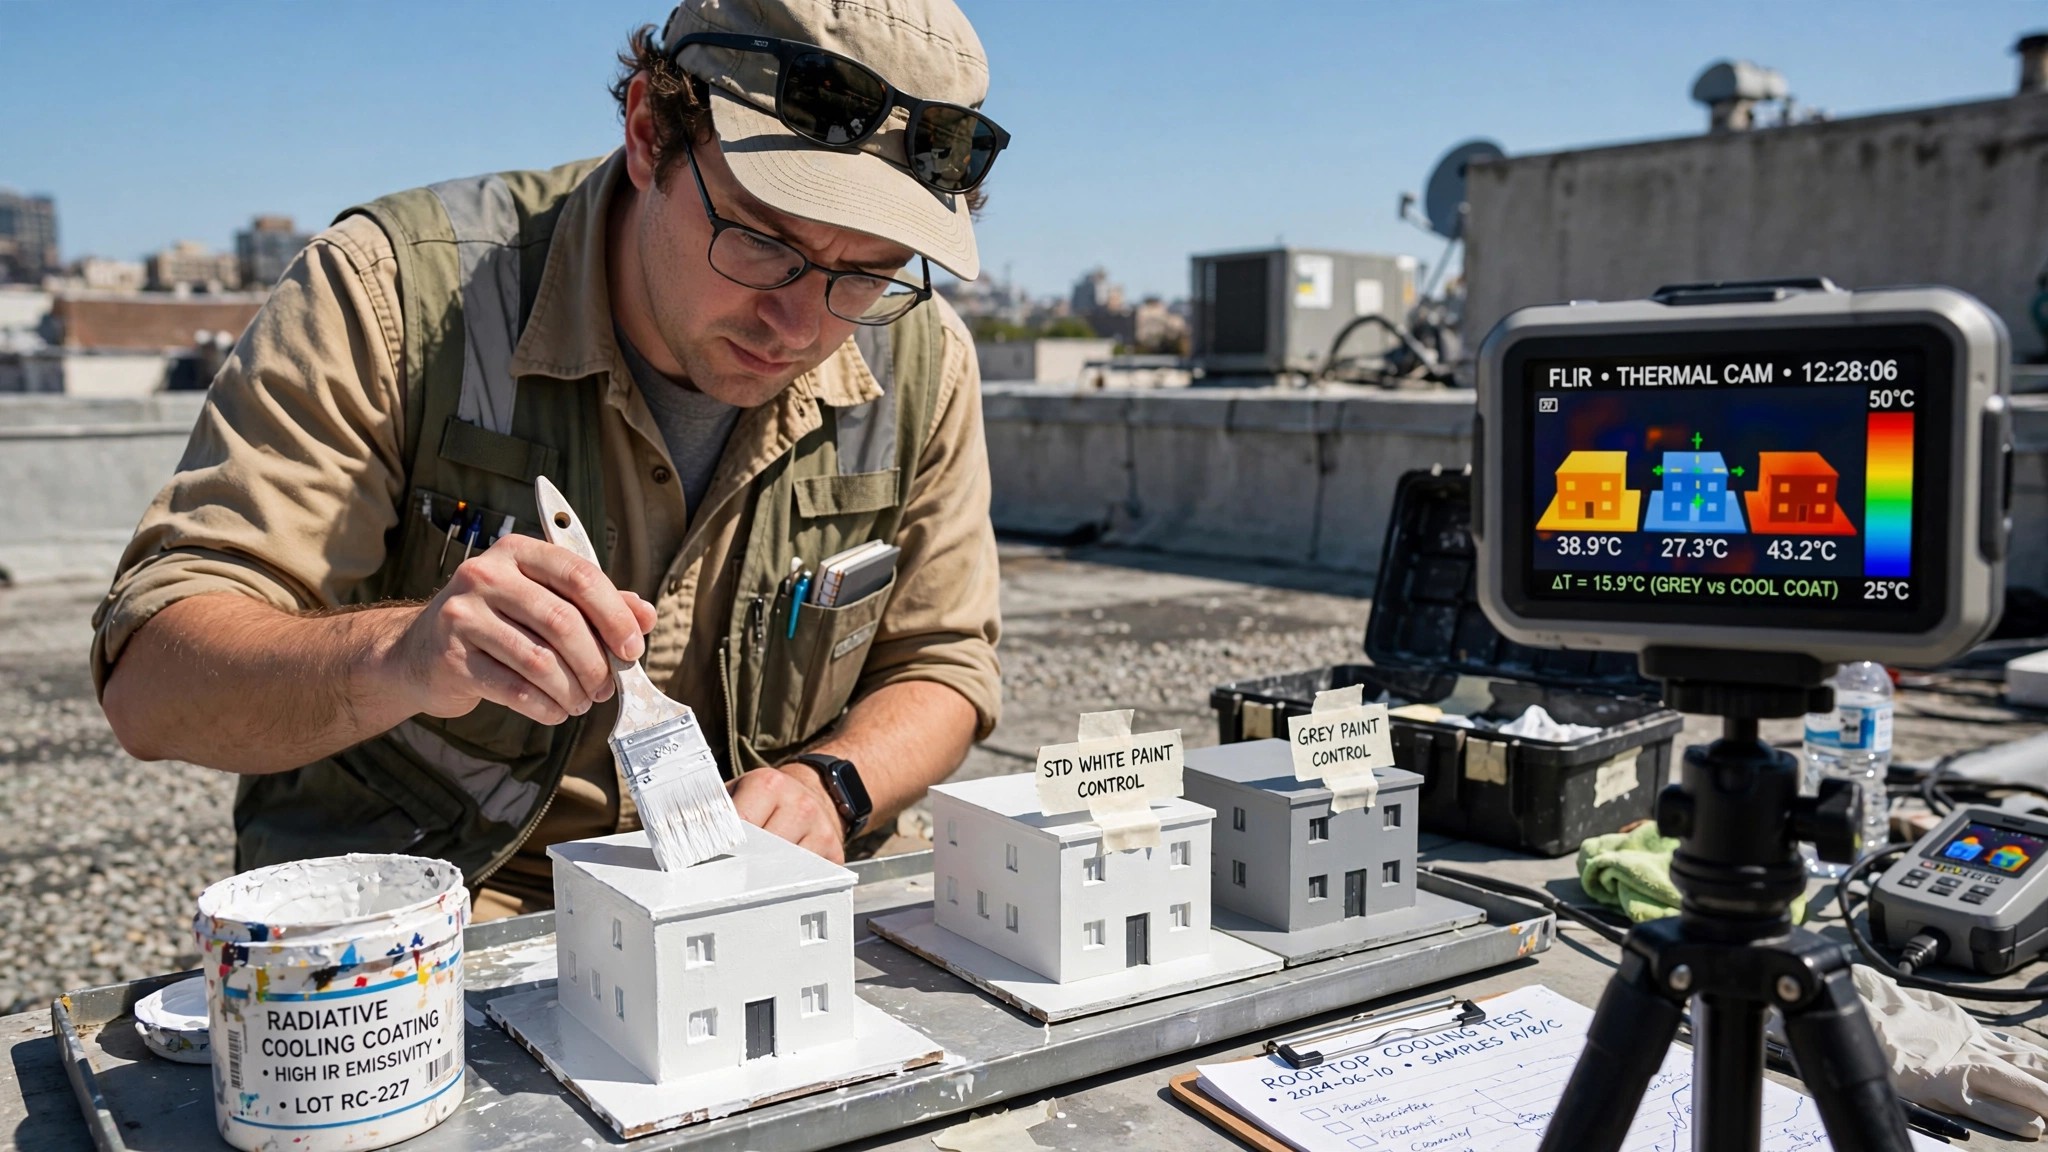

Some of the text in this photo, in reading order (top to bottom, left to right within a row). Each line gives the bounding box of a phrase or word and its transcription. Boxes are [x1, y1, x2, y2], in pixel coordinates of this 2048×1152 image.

[1549, 360, 1898, 388] FLIR THERMAL CAM 12:28:06
[1869, 390, 1915, 408] 50°C
[1557, 536, 1622, 556] 38.9°C
[1661, 538, 1728, 559] 27.3°C
[1767, 540, 1837, 561] 43.2°C
[1593, 575, 1645, 593] 15.9°C
[1650, 575, 1702, 596] (GREY
[1707, 581, 1725, 594] vs
[1730, 578, 1779, 597] COOL
[1784, 580, 1839, 600] COAT)
[1864, 582, 1910, 600] 25°C
[1297, 717, 1380, 746] GREY PAINT
[1043, 744, 1174, 778] STD WHITE PAINT
[1312, 745, 1371, 767] CONTROL
[1077, 775, 1145, 798] CONTROL
[267, 1000, 388, 1031] RADIATIVE
[262, 1010, 439, 1057] COOLING COATING
[275, 1039, 433, 1082] HIGH IR EMISSIVITY
[1261, 1009, 1533, 1090] ROOFTOP COOLING TEST
[1286, 1019, 1563, 1101] 2024-06-10 SAMPLES A/B/C
[295, 1079, 410, 1114] LOT RC-227
